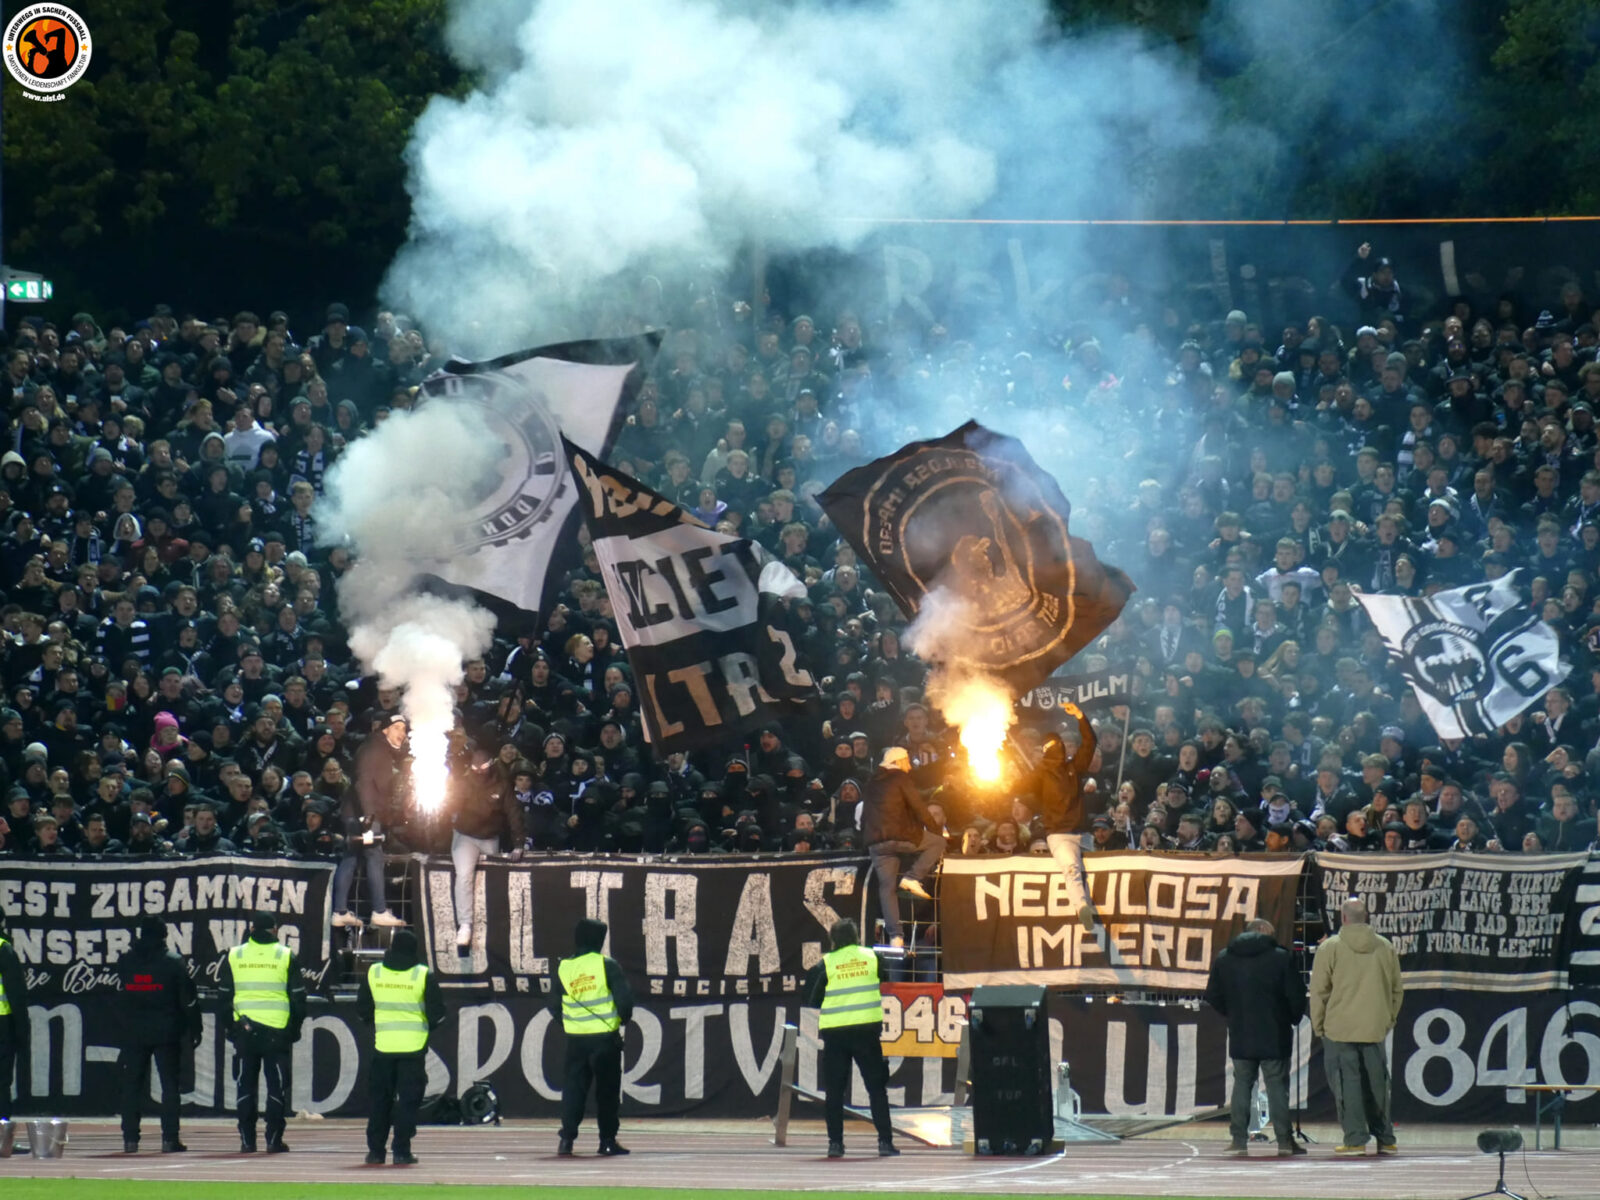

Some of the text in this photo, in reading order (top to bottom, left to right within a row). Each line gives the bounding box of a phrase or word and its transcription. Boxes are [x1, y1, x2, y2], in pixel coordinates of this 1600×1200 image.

[1078, 674, 1128, 703] ULM
[90, 874, 308, 918] ZUSAMMEN
[975, 872, 1260, 922] NEBULOSA
[1322, 868, 1565, 894] DAS ZIEL DAS IST EINE KURVE
[1385, 888, 1453, 913] MINUTEN
[1459, 890, 1502, 914] LANG
[1509, 893, 1552, 915] BEBT
[208, 919, 301, 956] WG
[429, 866, 858, 978] ULTRAS
[1369, 910, 1435, 933] MINUTEN
[1441, 910, 1467, 932] AM
[1474, 912, 1508, 935] RAD
[1016, 922, 1212, 972] IMPERO
[836, 969, 869, 980] STEWARD
